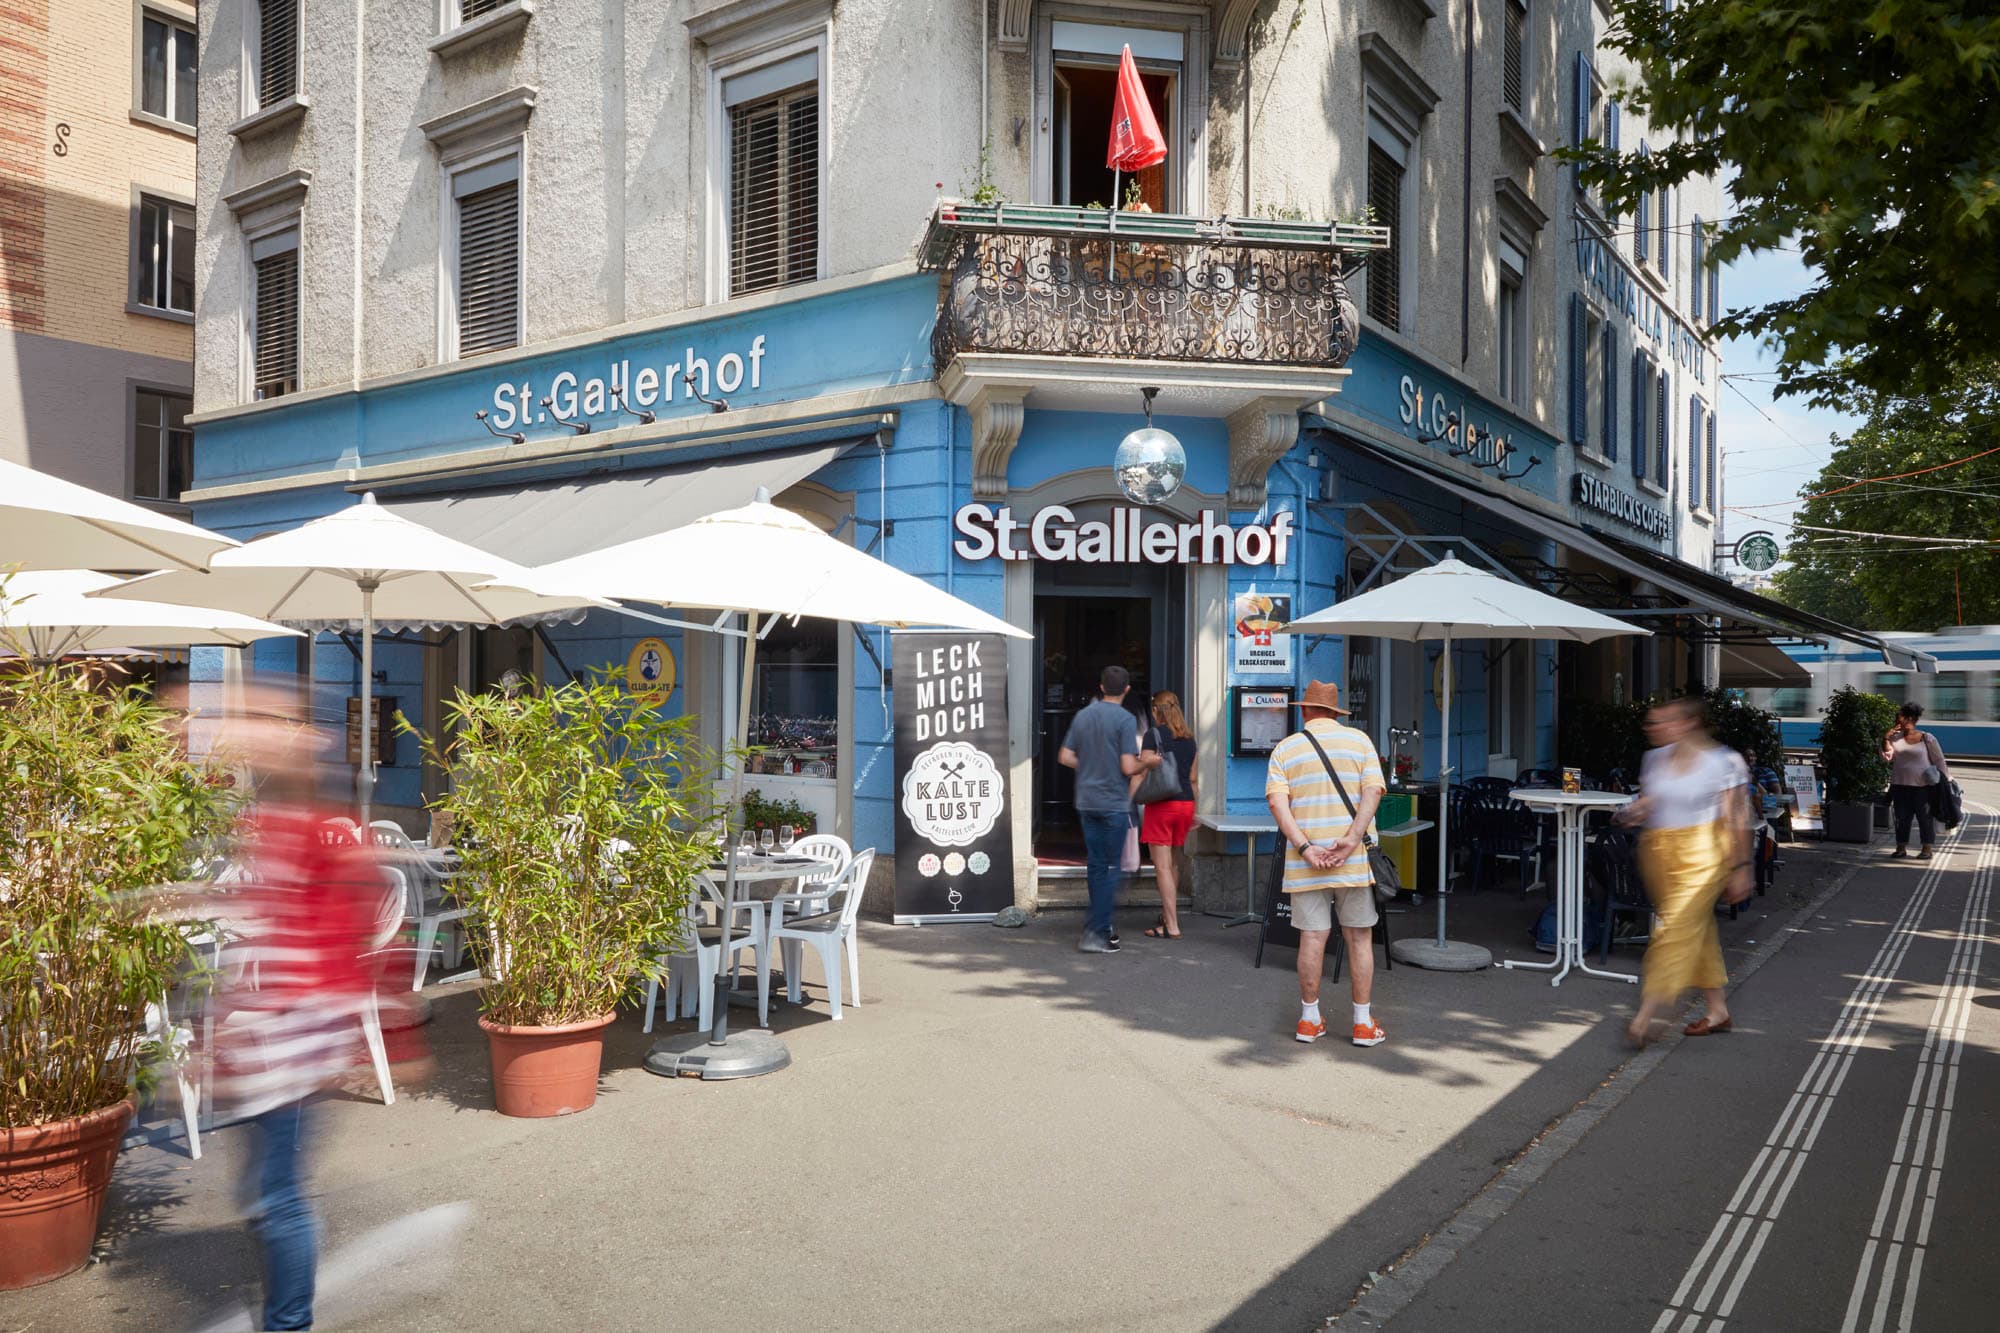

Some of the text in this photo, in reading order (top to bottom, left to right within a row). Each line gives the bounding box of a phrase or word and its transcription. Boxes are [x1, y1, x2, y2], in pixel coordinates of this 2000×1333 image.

[492, 334, 766, 429] St.Gallerhof
[1580, 472, 1674, 541] STARBUCKS COFFEE
[953, 502, 1295, 567] St.Gallerhof
[916, 641, 982, 679] LECK
[916, 671, 983, 711] MICH
[1255, 695, 1286, 705] CALANDA
[916, 702, 985, 742] DOCH
[916, 779, 990, 800] KALTE
[926, 801, 982, 821] LUST
